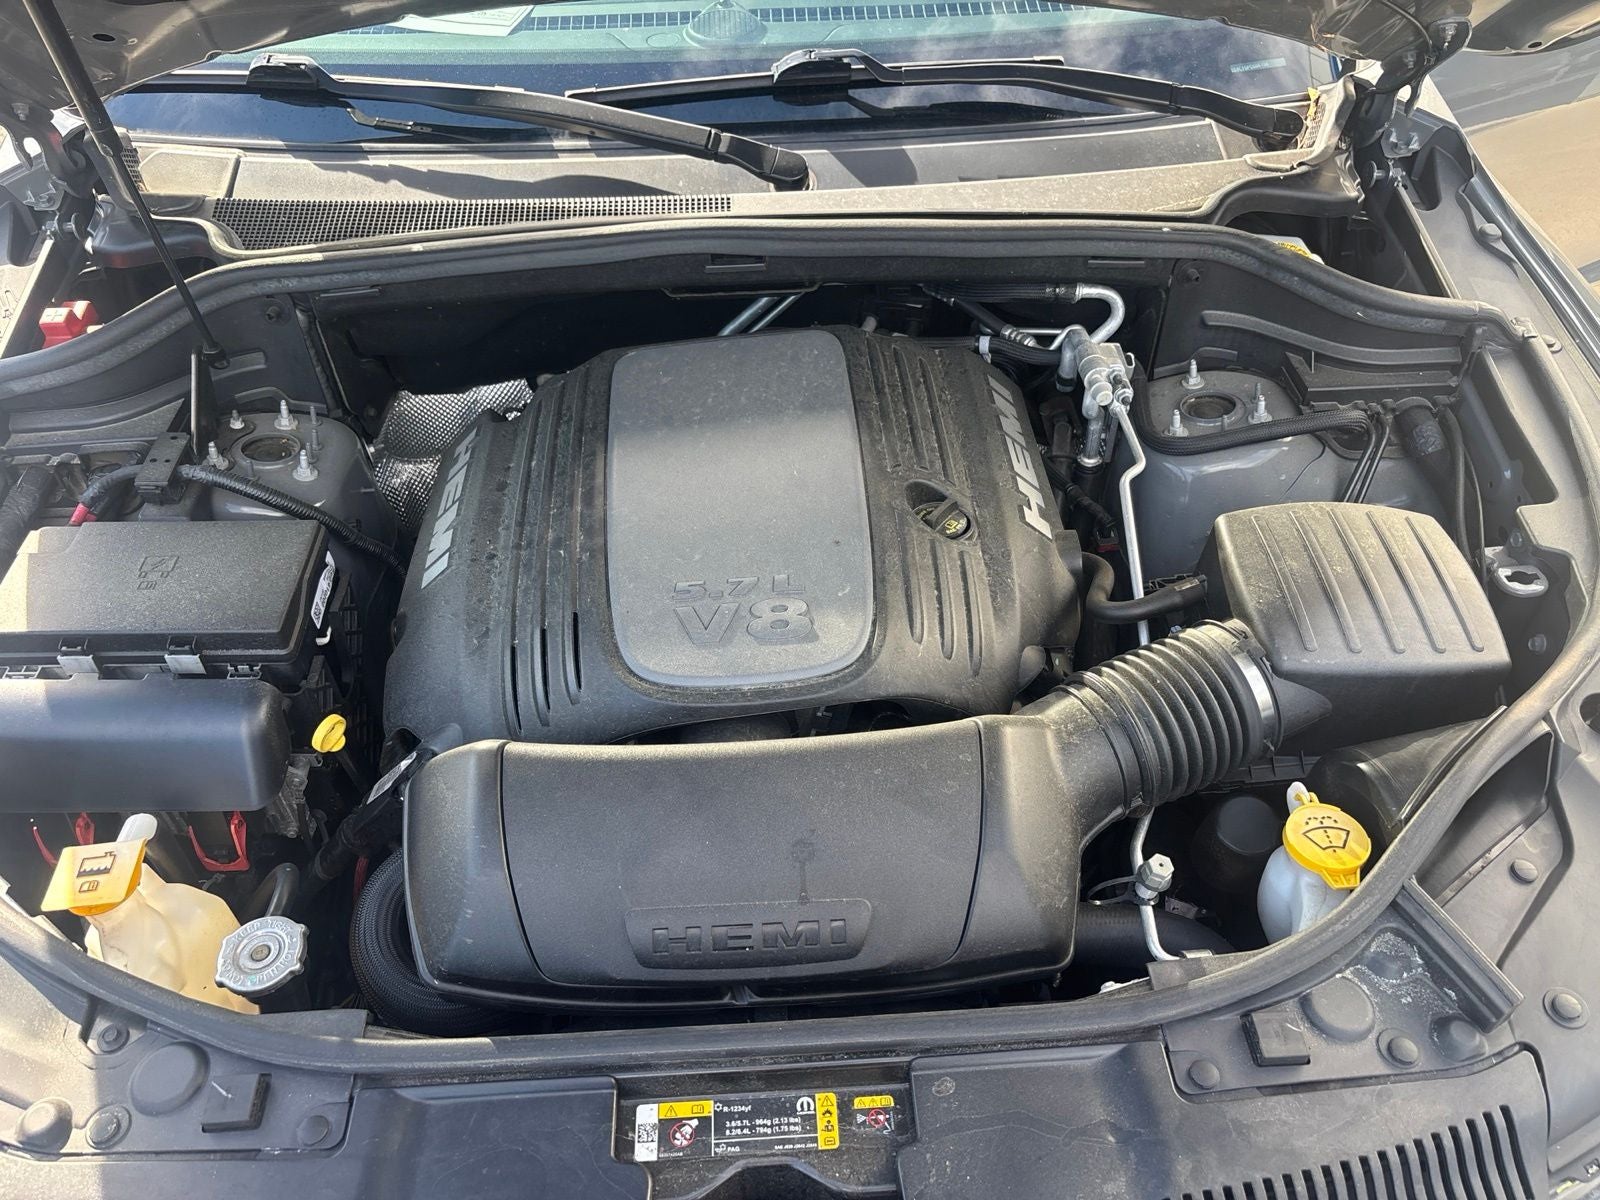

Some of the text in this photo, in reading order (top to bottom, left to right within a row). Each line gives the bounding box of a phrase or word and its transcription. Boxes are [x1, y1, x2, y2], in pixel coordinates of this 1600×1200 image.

[987, 374, 1053, 540] HEMI
[420, 426, 478, 590] HEMI
[673, 598, 815, 644] V8
[652, 918, 848, 955] HEMI
[723, 1104, 752, 1112] R-1234yf
[772, 1125, 788, 1133] (1.75
